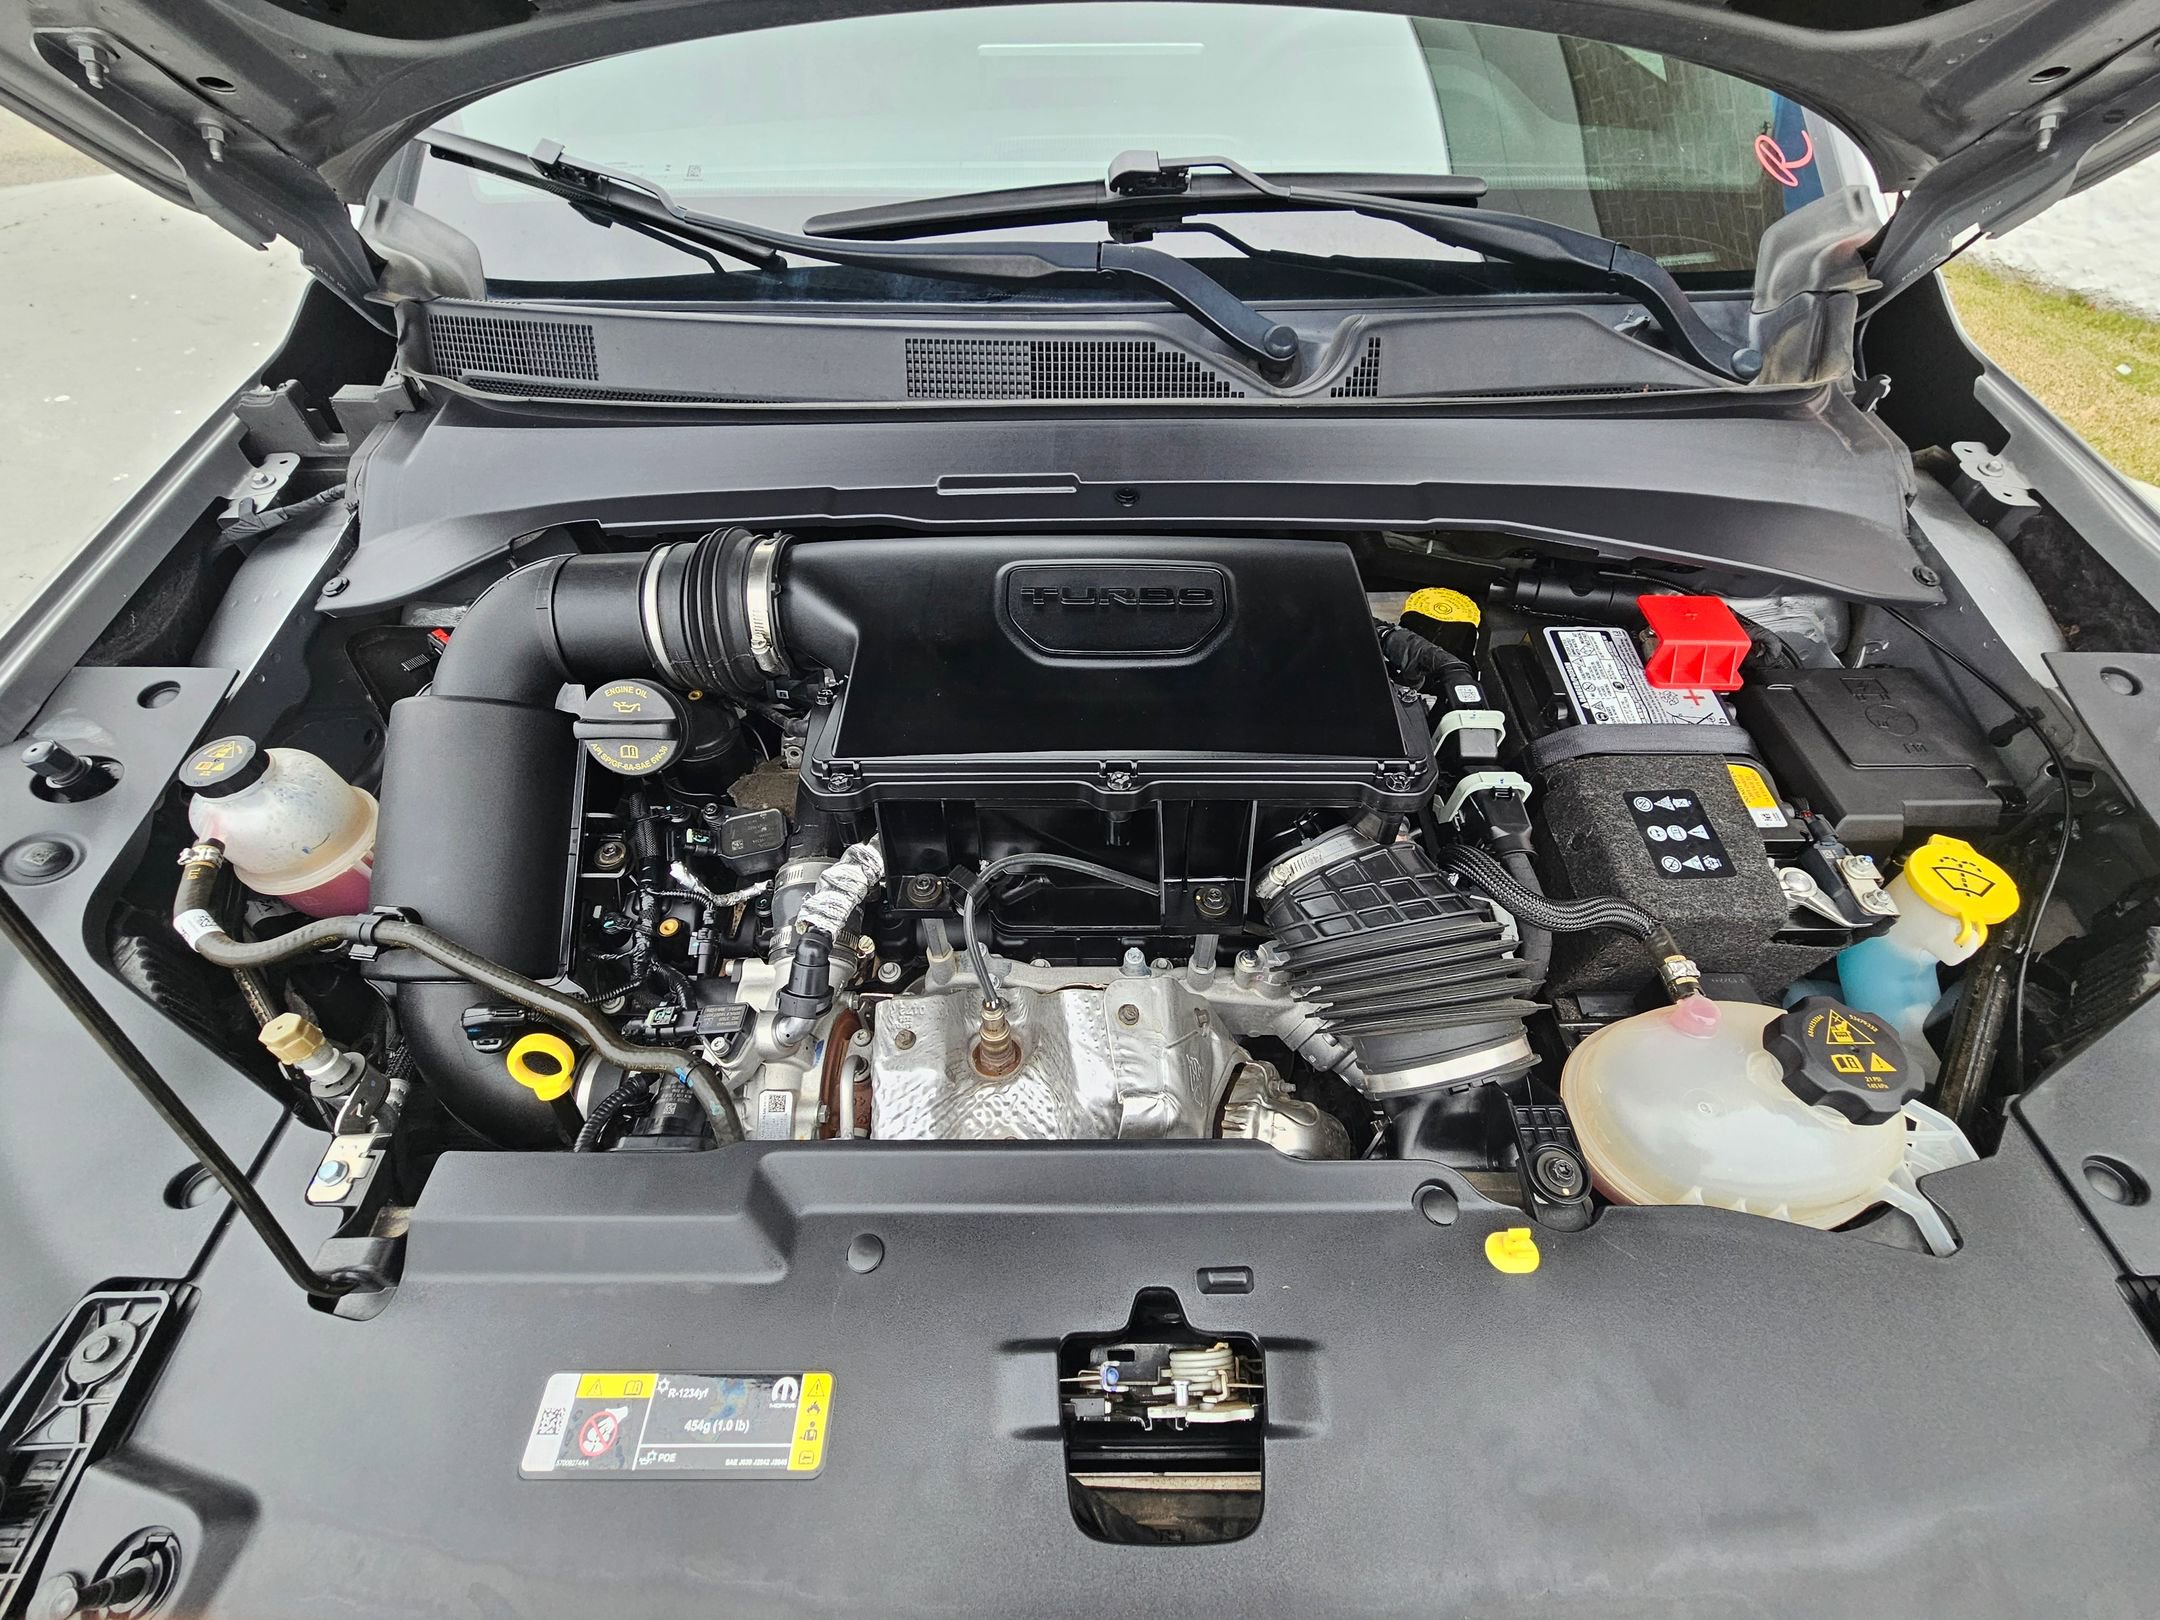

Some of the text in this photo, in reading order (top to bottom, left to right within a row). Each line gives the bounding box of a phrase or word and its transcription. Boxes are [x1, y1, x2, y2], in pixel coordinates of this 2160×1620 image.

[1020, 586, 1214, 607] TURBO
[604, 686, 648, 699] ENGINE OIL
[591, 743, 602, 757] API
[650, 745, 668, 764] 5W-30
[667, 1387, 710, 1400] R-1234yf
[684, 1419, 750, 1434] 454g (1.0 lb)
[658, 1453, 677, 1463] POE
